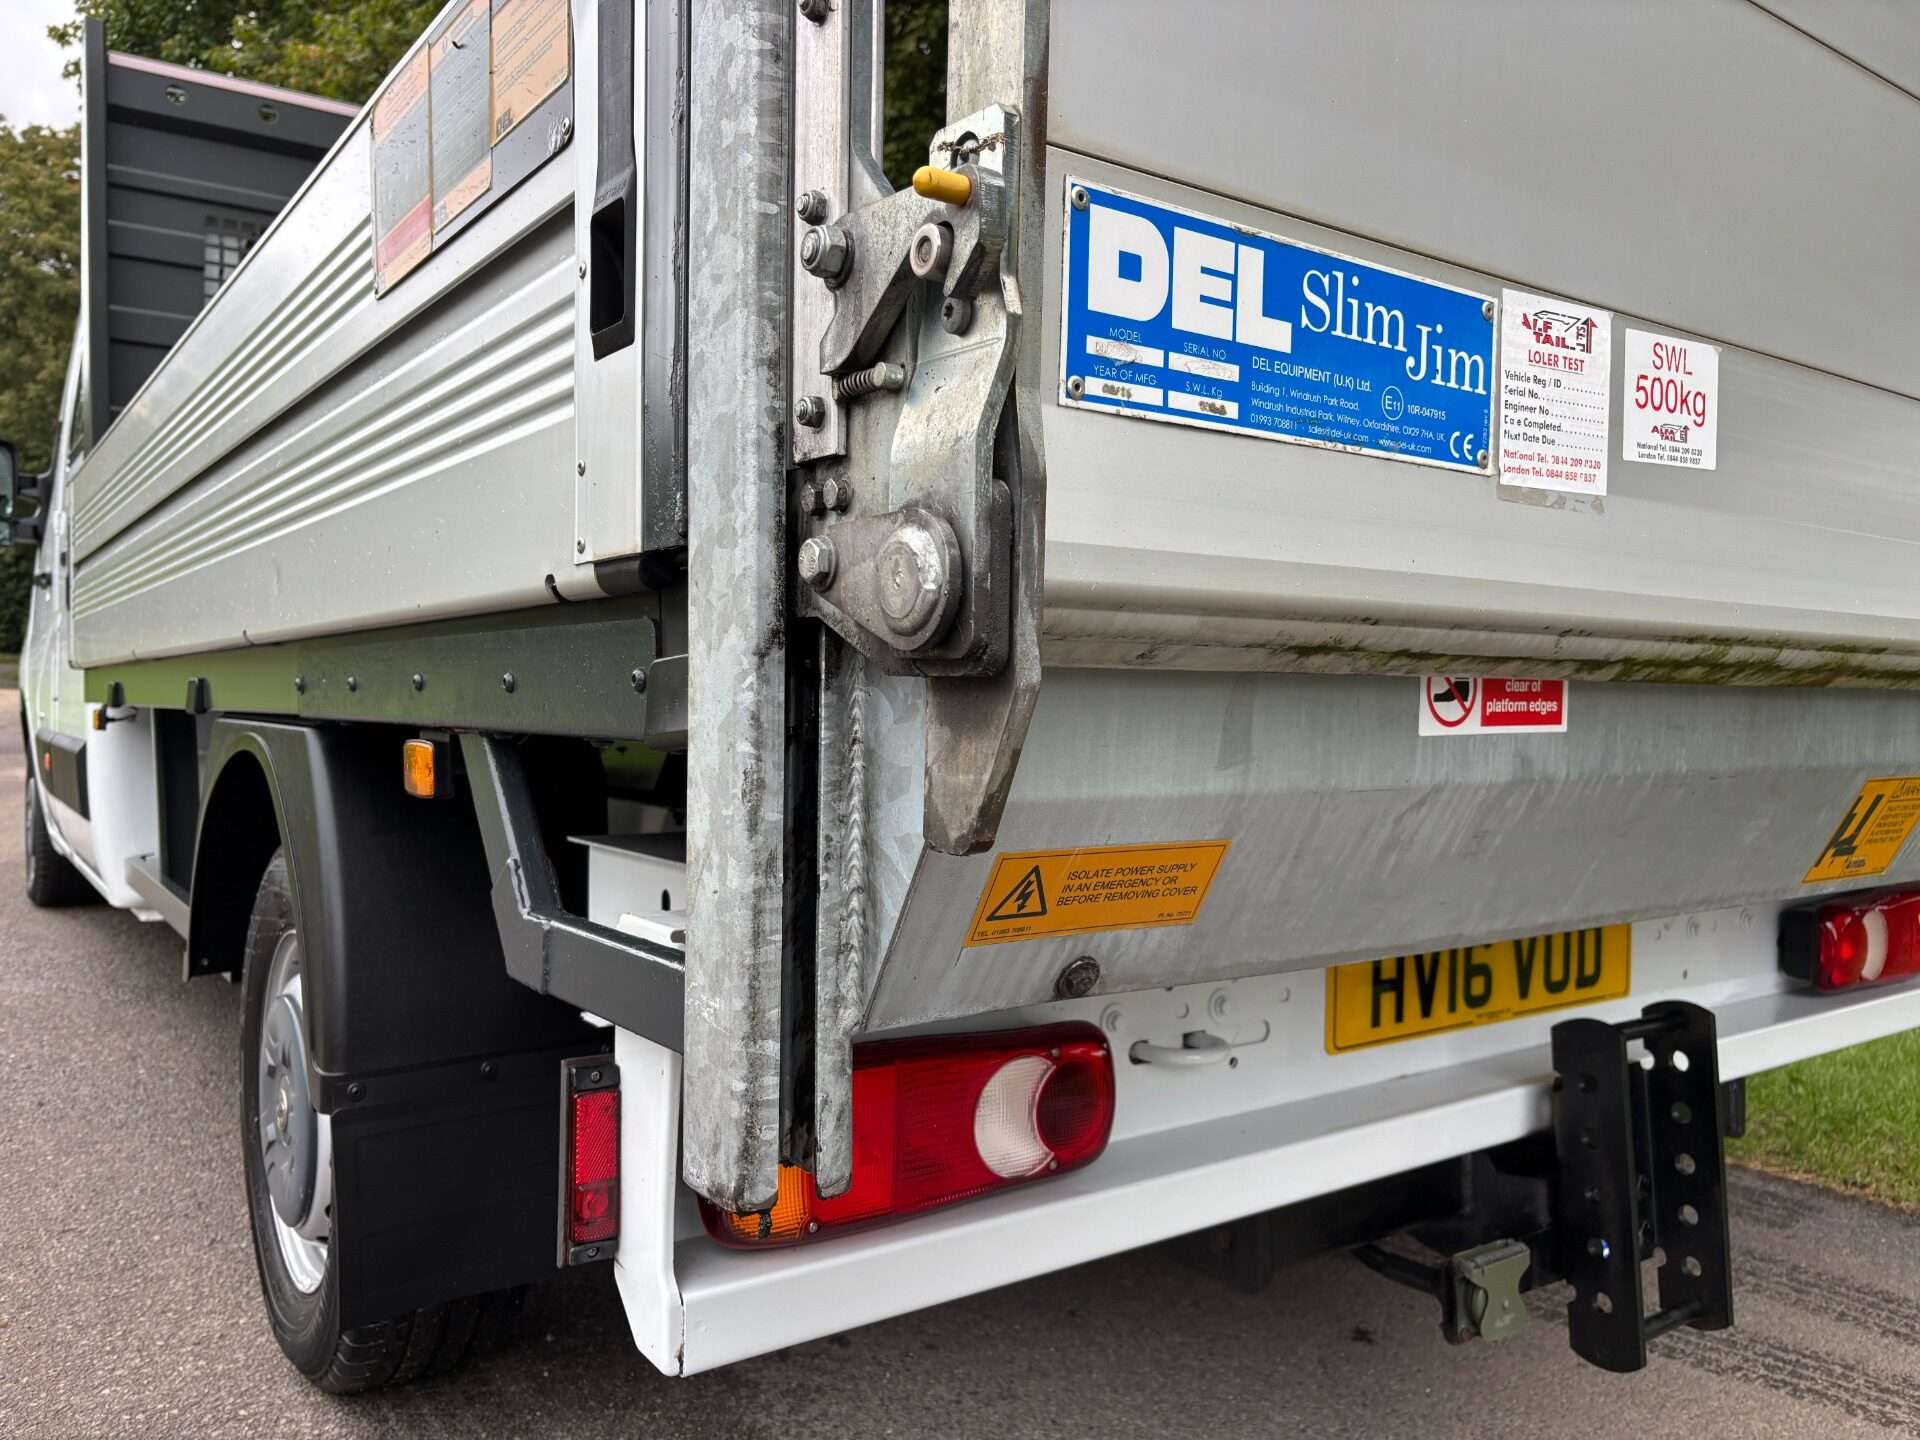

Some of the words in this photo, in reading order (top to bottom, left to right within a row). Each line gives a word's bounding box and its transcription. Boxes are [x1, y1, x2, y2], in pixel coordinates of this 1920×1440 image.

[1088, 203, 1293, 354] DEL
[1301, 270, 1407, 352] Slim
[1406, 324, 1487, 395] Jim
[1109, 328, 1142, 343] MODEL
[1183, 342, 1210, 358] SERIAL
[1213, 349, 1227, 361] NO
[1528, 349, 1560, 368] LOLER
[1562, 356, 1585, 372] TEST
[1652, 342, 1693, 376] SWL
[1093, 364, 1117, 379] YEAR
[1120, 370, 1133, 381] OF
[1136, 373, 1157, 386] MFG
[1252, 356, 1272, 372] DEL
[1274, 361, 1332, 384] EQUIPMENT
[1333, 373, 1355, 391] (U.K)
[1357, 378, 1373, 393] Ltd.
[1504, 369, 1531, 384] Vehicle
[1533, 374, 1547, 389] Reg
[1212, 387, 1223, 400] Kg
[1251, 380, 1280, 398] Building
[1290, 387, 1322, 404] Windrush
[1323, 394, 1338, 407] Park
[1504, 384, 1526, 397] Serial
[1251, 397, 1284, 413] Windrush
[1286, 403, 1317, 419] Industrial
[1635, 374, 1706, 428] 500kg
[1408, 404, 1446, 421] 10R-047915
[1539, 406, 1550, 417] No
[1250, 413, 1272, 426] 01993
[1274, 417, 1297, 431] 708811
[1522, 432, 1540, 445] Date
[1542, 435, 1556, 446] Due
[1503, 448, 1535, 462] National
[1537, 453, 1549, 464] Tel.
[1503, 463, 1530, 476] London
[1532, 466, 1545, 477] Tel.
[1546, 468, 1564, 480] 0844
[1505, 678, 1530, 692] clear
[1486, 698, 1527, 716] platform
[1529, 698, 1558, 715] edges
[1066, 867, 1113, 881] ISOLATE
[1114, 865, 1155, 878] POWER
[1157, 862, 1198, 873] SUPPLY
[1061, 884, 1075, 893] IN
[1075, 882, 1091, 892] AN
[1093, 876, 1161, 891] EMERGENCY
[1162, 875, 1179, 885] OR
[1056, 894, 1102, 907] BEFORE
[1103, 888, 1160, 902] REMOVING
[1161, 886, 1198, 897] COVER
[1370, 944, 1493, 1028] HV16
